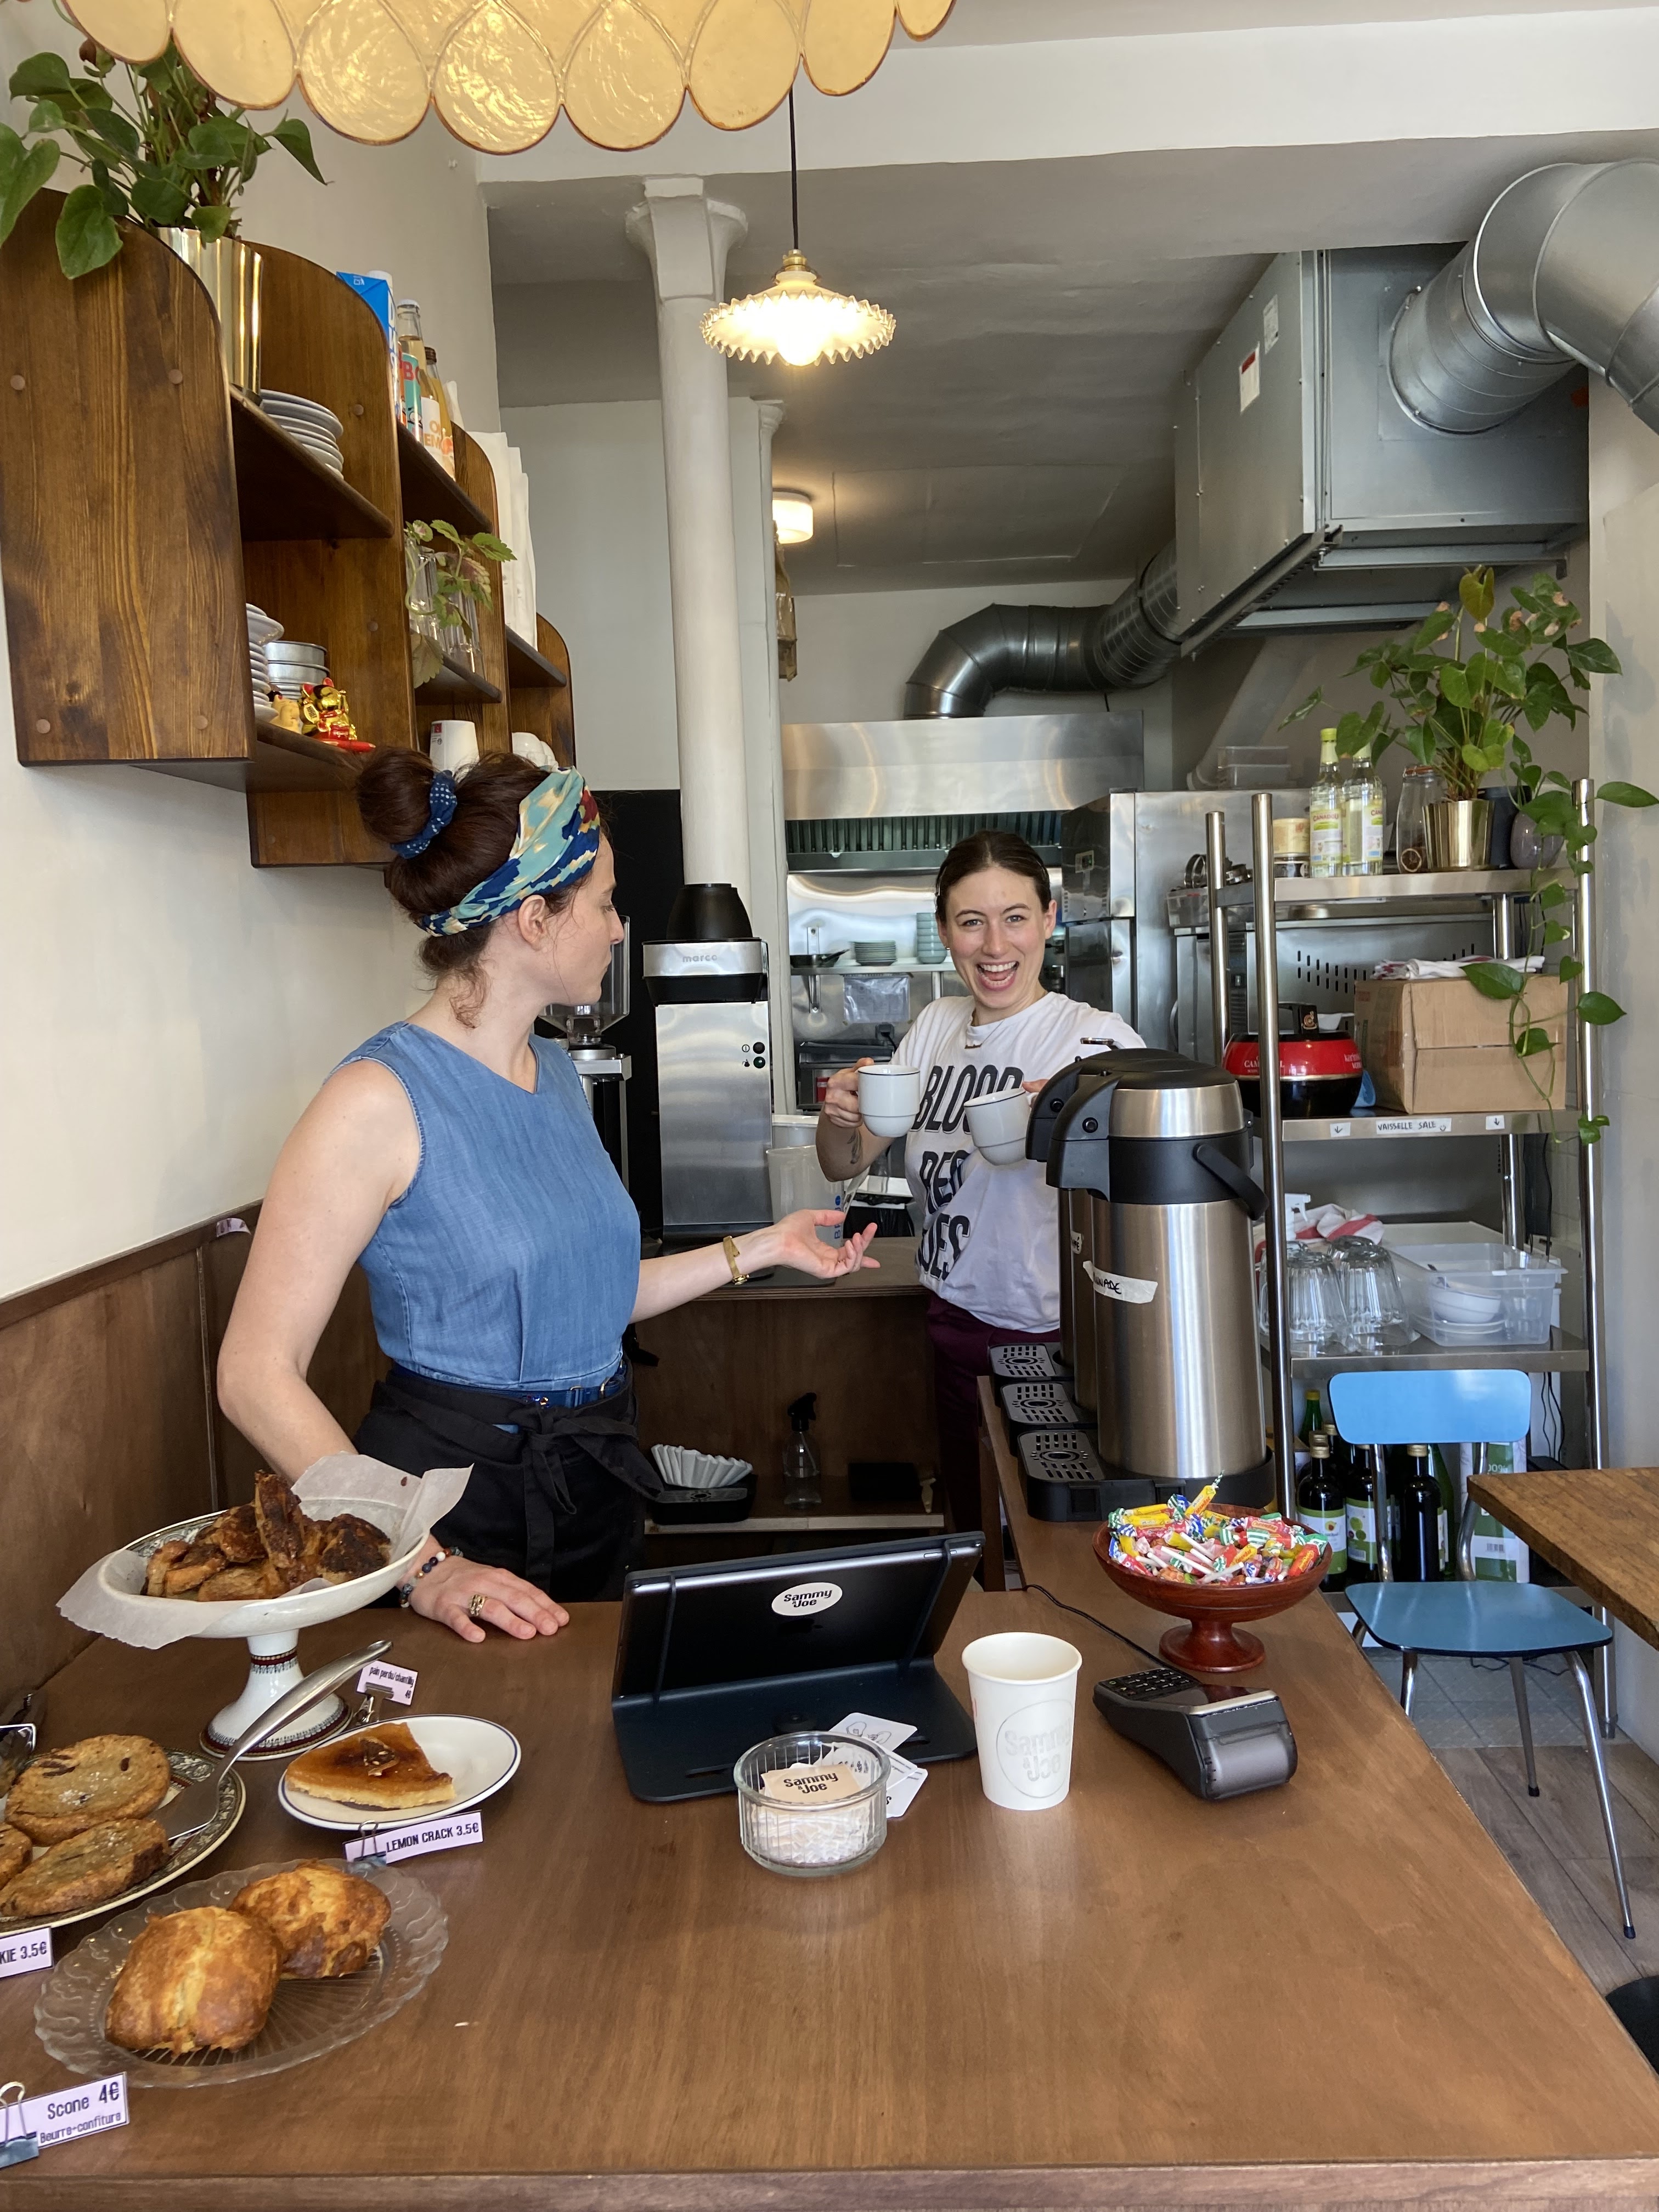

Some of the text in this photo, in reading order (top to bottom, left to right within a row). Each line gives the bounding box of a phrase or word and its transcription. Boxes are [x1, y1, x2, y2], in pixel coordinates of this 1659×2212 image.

[1313, 812, 1339, 822] CANADOU
[1378, 1121, 1437, 1131] VAISSELLE SALE
[783, 1590, 833, 1602] Sammy
[369, 1667, 380, 1677] pain
[783, 1773, 839, 1787] Sammy
[802, 1782, 828, 1793] Joe
[386, 1822, 479, 1853] LEMON CRACK 3.5€
[20, 1941, 47, 1959] 3.5€
[47, 2081, 119, 2120] Scone 4€
[40, 2112, 121, 2143] Beurre+confiture
